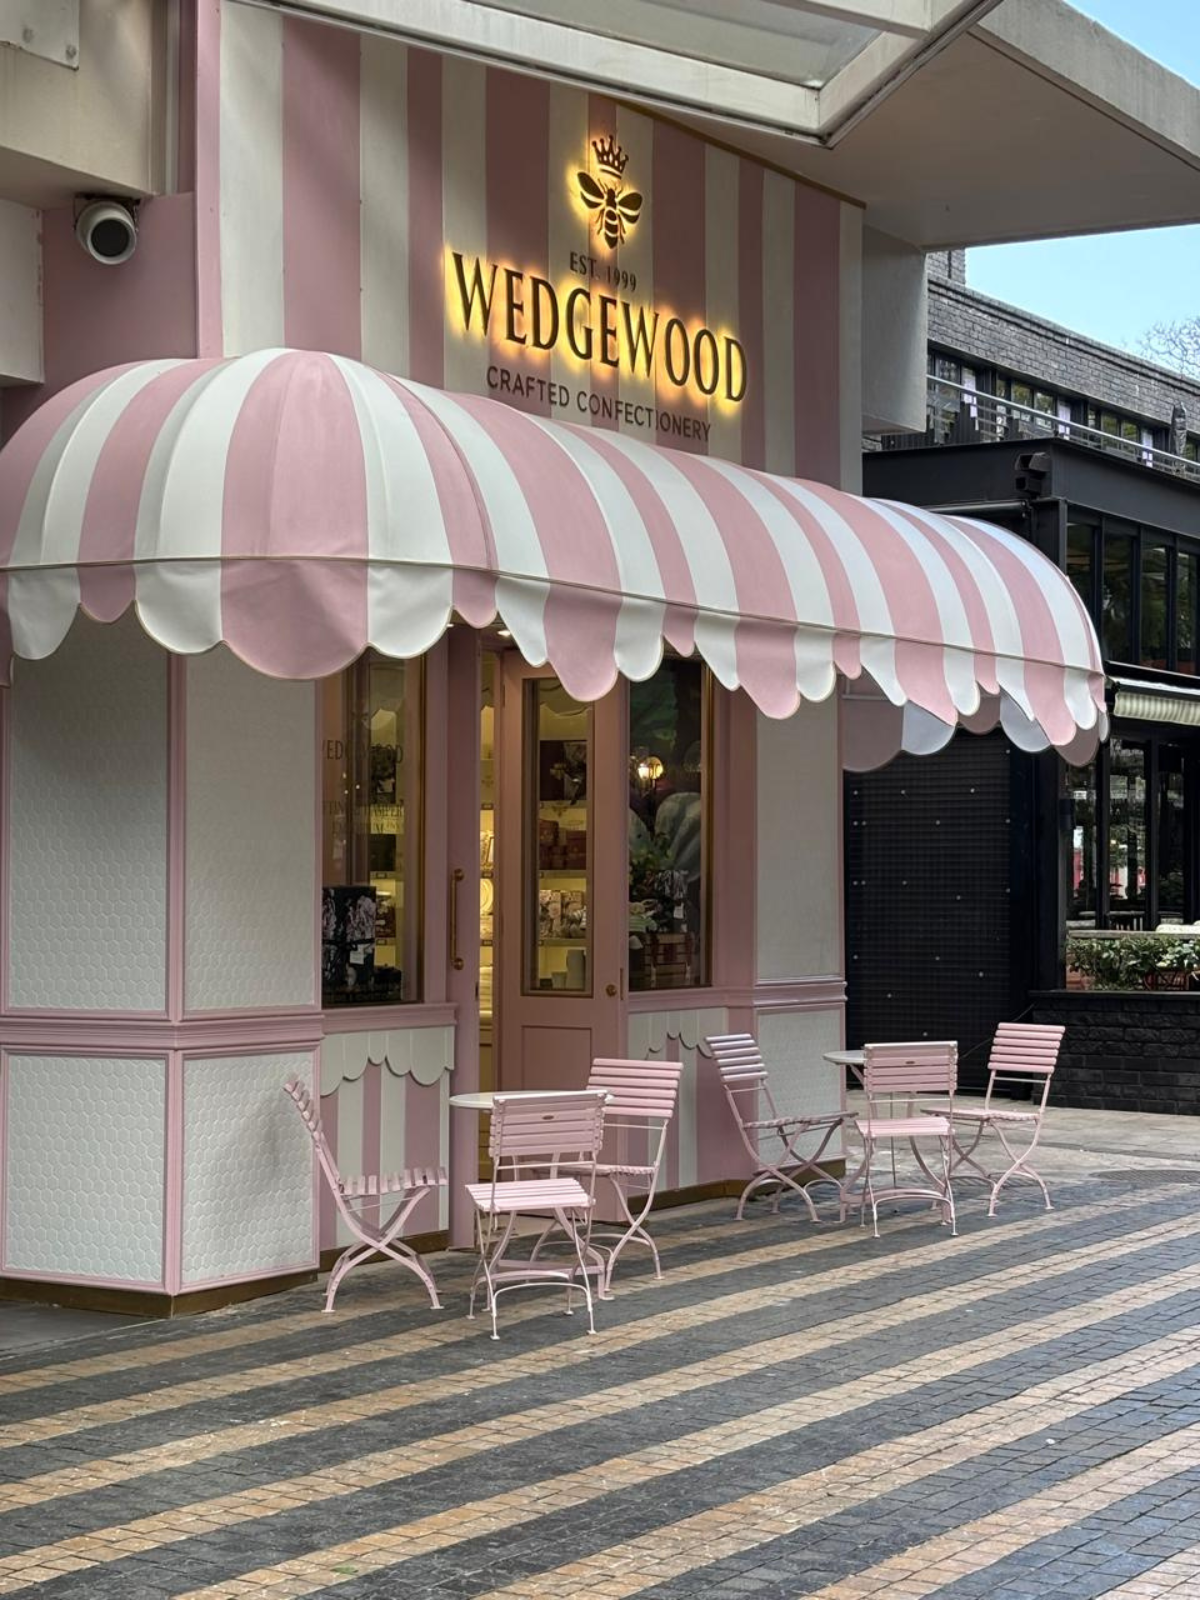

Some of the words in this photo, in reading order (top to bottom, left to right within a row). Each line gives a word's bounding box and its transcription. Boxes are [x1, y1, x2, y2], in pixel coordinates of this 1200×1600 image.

[570, 251, 601, 279] EST.
[607, 266, 637, 292] 1999
[453, 252, 747, 402] WEDGEWOOD
[486, 365, 570, 408] CRAFTED
[576, 390, 711, 442] CONFECTIONERY
